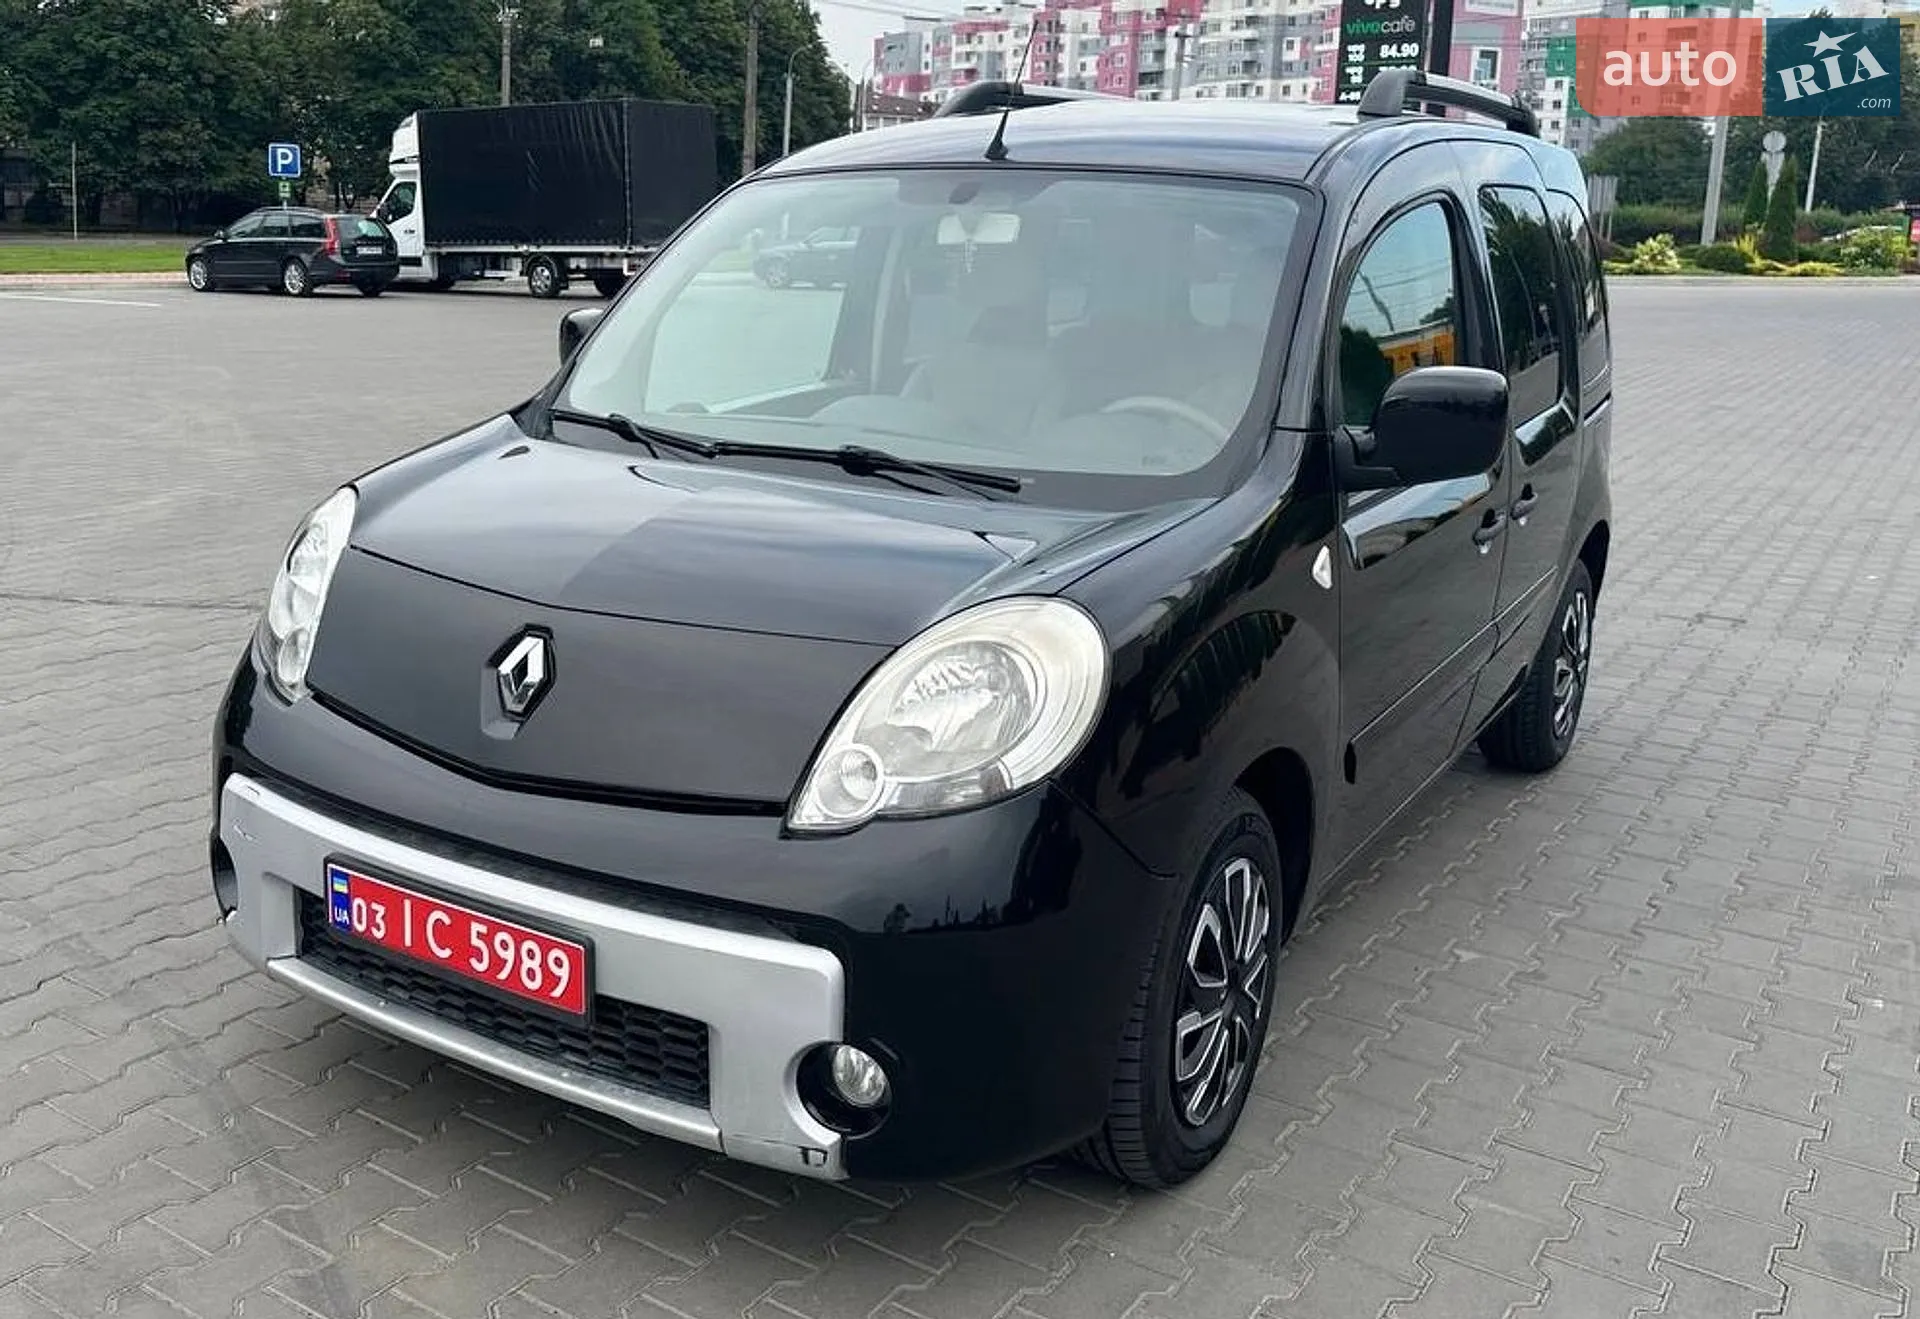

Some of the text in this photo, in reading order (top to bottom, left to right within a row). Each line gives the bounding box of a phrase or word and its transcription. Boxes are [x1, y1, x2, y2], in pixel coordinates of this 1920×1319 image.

[1380, 43, 1420, 58] 84.90
[276, 148, 293, 173] P
[334, 906, 350, 926] UA
[352, 897, 387, 939] 03
[468, 920, 571, 998] 5989
